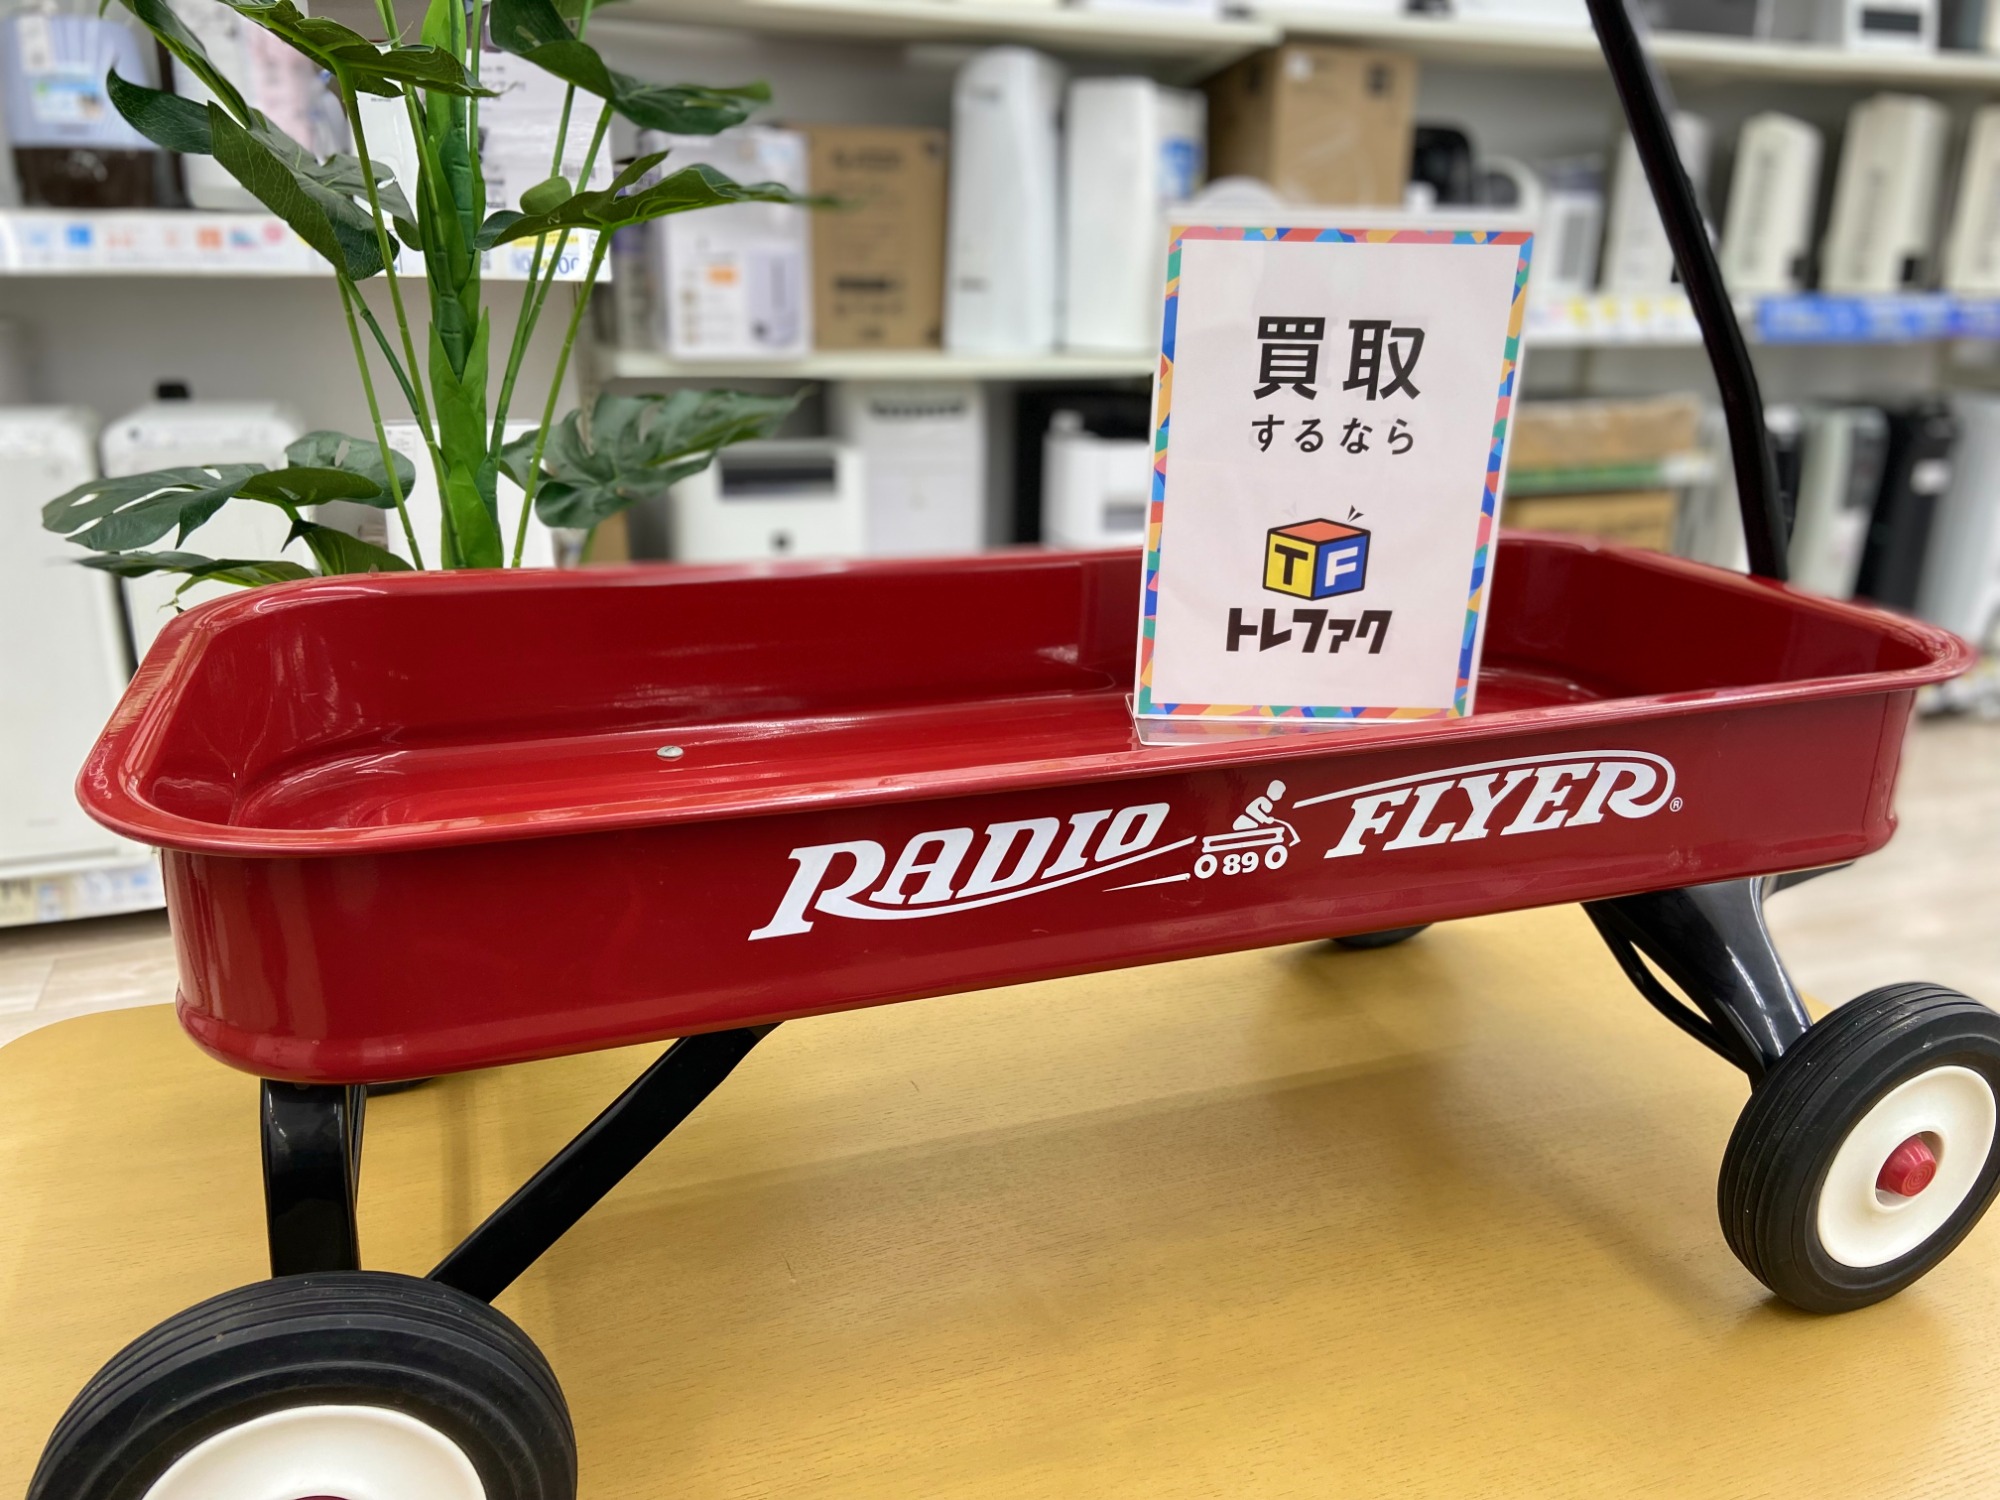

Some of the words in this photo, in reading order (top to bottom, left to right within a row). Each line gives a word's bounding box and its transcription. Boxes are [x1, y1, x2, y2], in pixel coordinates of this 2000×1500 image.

[1253, 316, 1426, 401] 買取
[1251, 414, 1415, 455] するなら
[1274, 544, 1359, 587] TF
[1225, 607, 1393, 655] トレファク
[748, 802, 1171, 941] RADIO
[1323, 750, 1676, 859] FLYER
